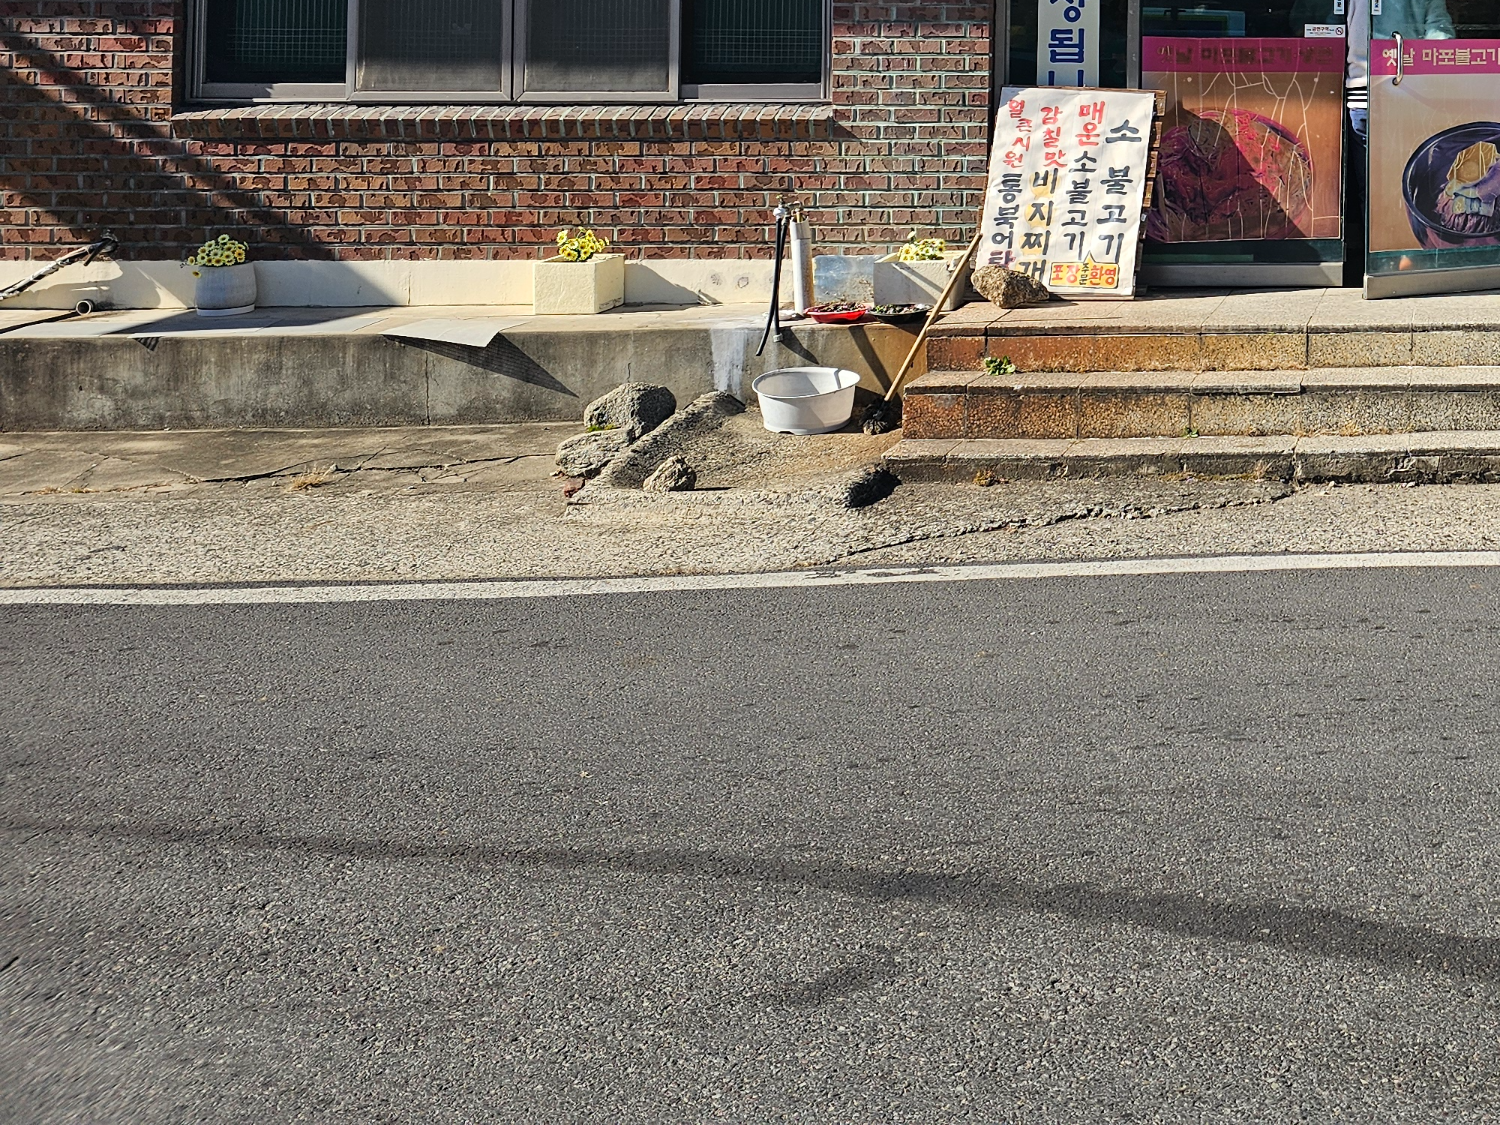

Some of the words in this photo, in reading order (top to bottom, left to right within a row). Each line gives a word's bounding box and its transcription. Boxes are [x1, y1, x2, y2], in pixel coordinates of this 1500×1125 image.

[1040, 105, 1068, 168] 감칠맛
[1075, 101, 1106, 147] 매운
[1018, 167, 1059, 281] 비지찌개
[1061, 150, 1098, 260] 소불고기
[1096, 119, 1142, 263] 소불고기
